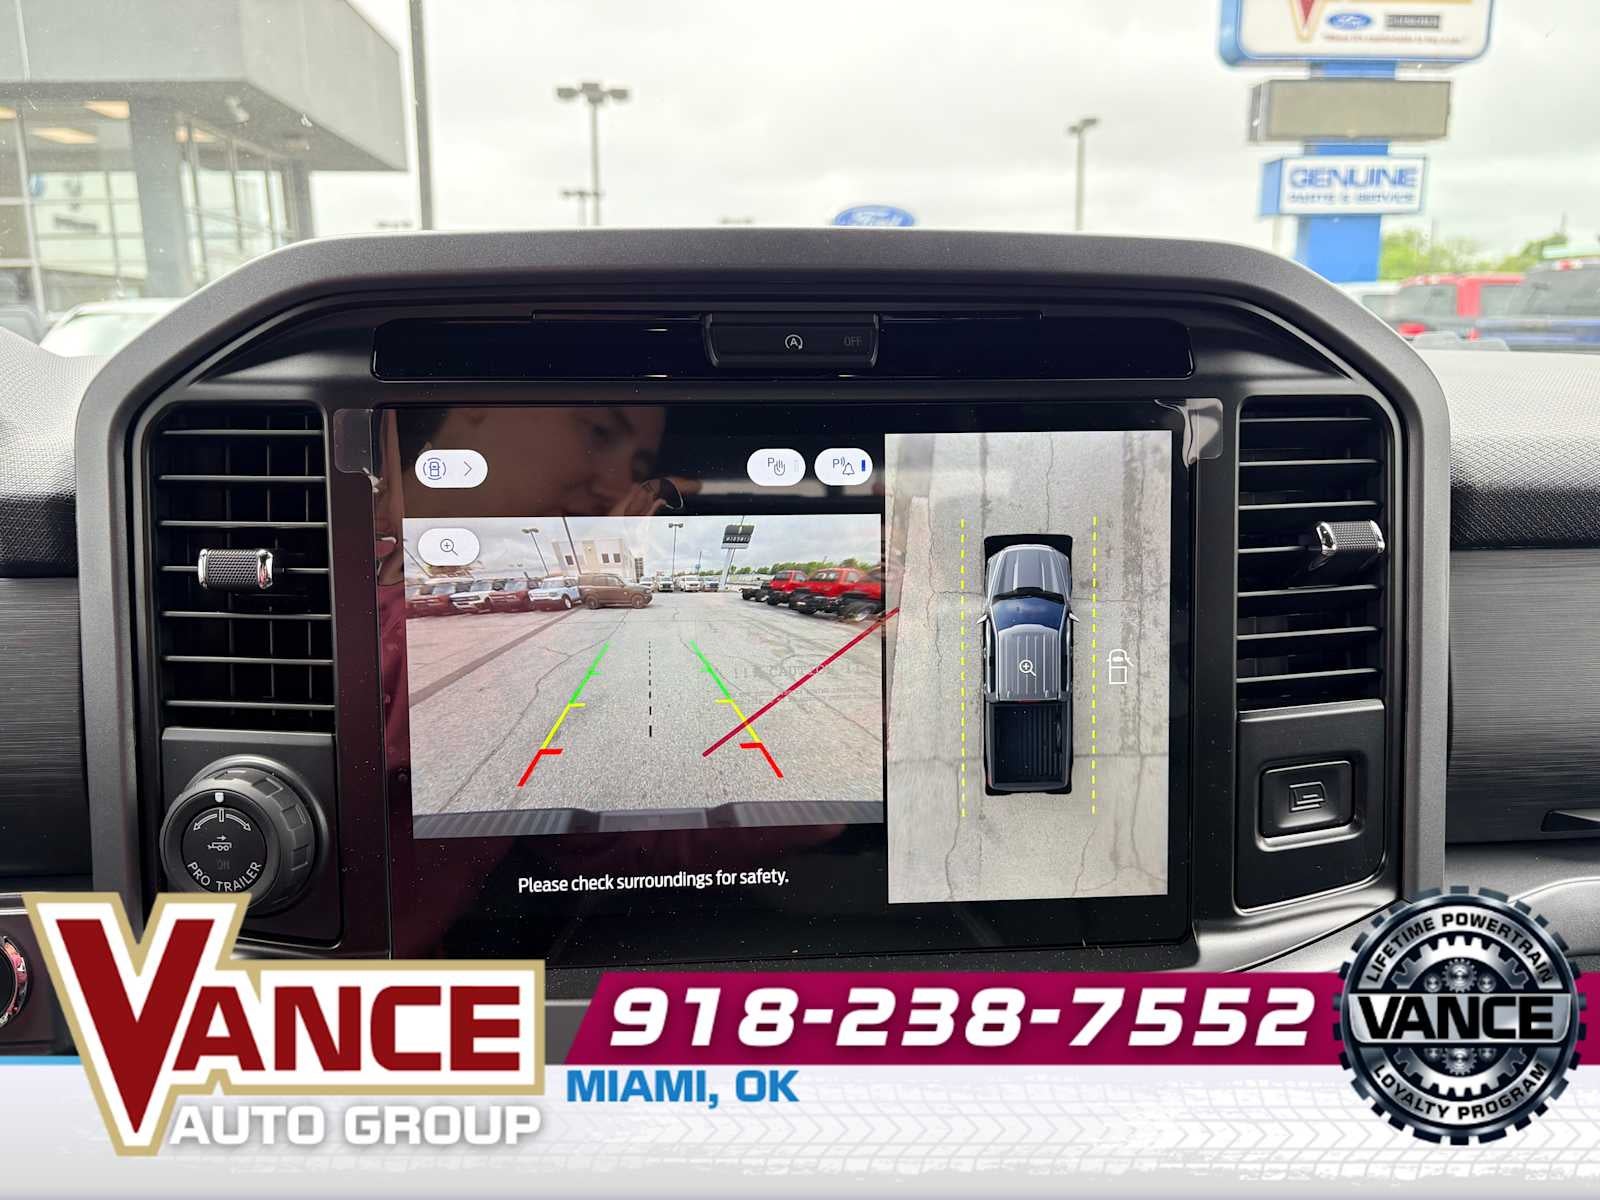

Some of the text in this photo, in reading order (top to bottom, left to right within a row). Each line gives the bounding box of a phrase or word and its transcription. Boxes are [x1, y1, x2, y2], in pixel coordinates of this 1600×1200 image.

[1290, 167, 1417, 188] GENUINE
[843, 336, 863, 347] OFF
[187, 861, 263, 893] PRO TRAILER
[518, 867, 790, 893] Please check surroundings for safety.
